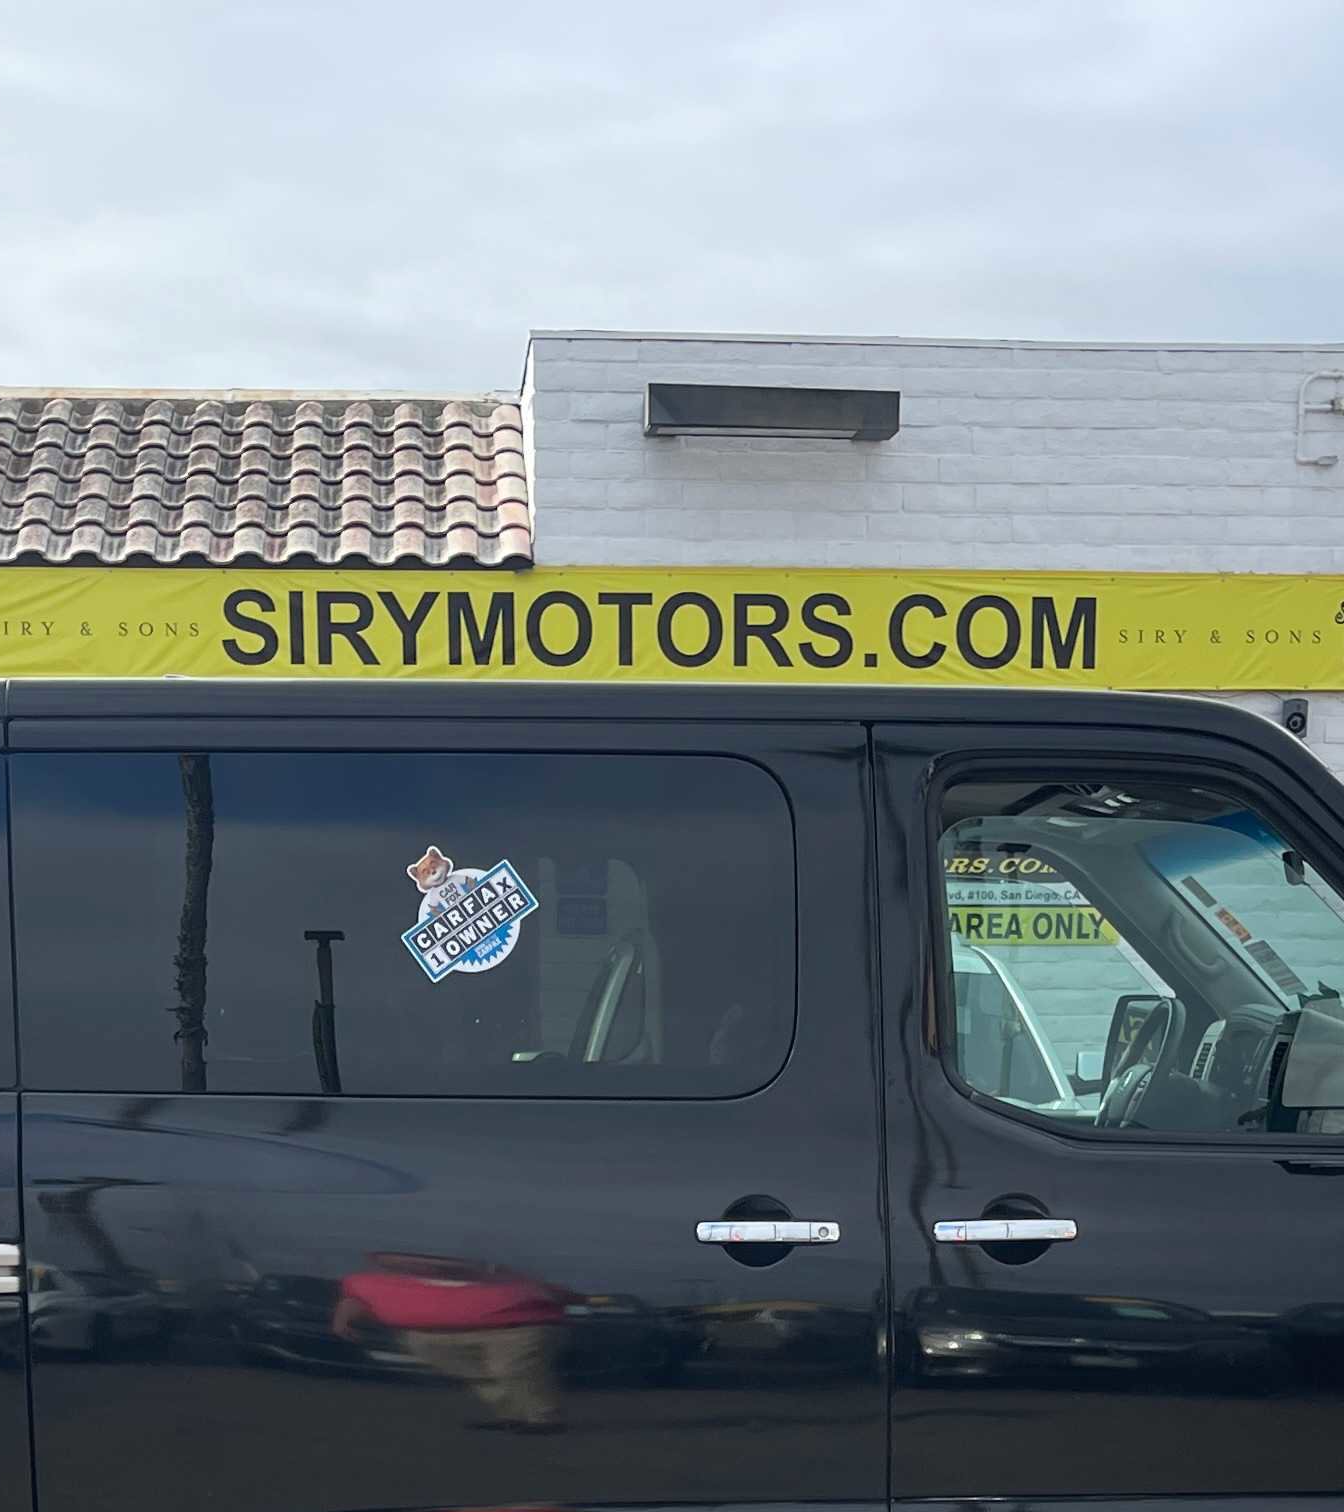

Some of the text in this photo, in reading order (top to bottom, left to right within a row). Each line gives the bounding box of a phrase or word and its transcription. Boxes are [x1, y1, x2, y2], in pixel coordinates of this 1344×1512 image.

[79, 621, 94, 637] &
[118, 621, 201, 638] SONS
[221, 589, 1098, 672] SIRYMOTORS.COM
[1118, 628, 1323, 645] SIRY & SONS
[1001, 888, 1022, 901] San
[416, 876, 513, 949] CARFAX
[951, 912, 1104, 940] AREA ONLY
